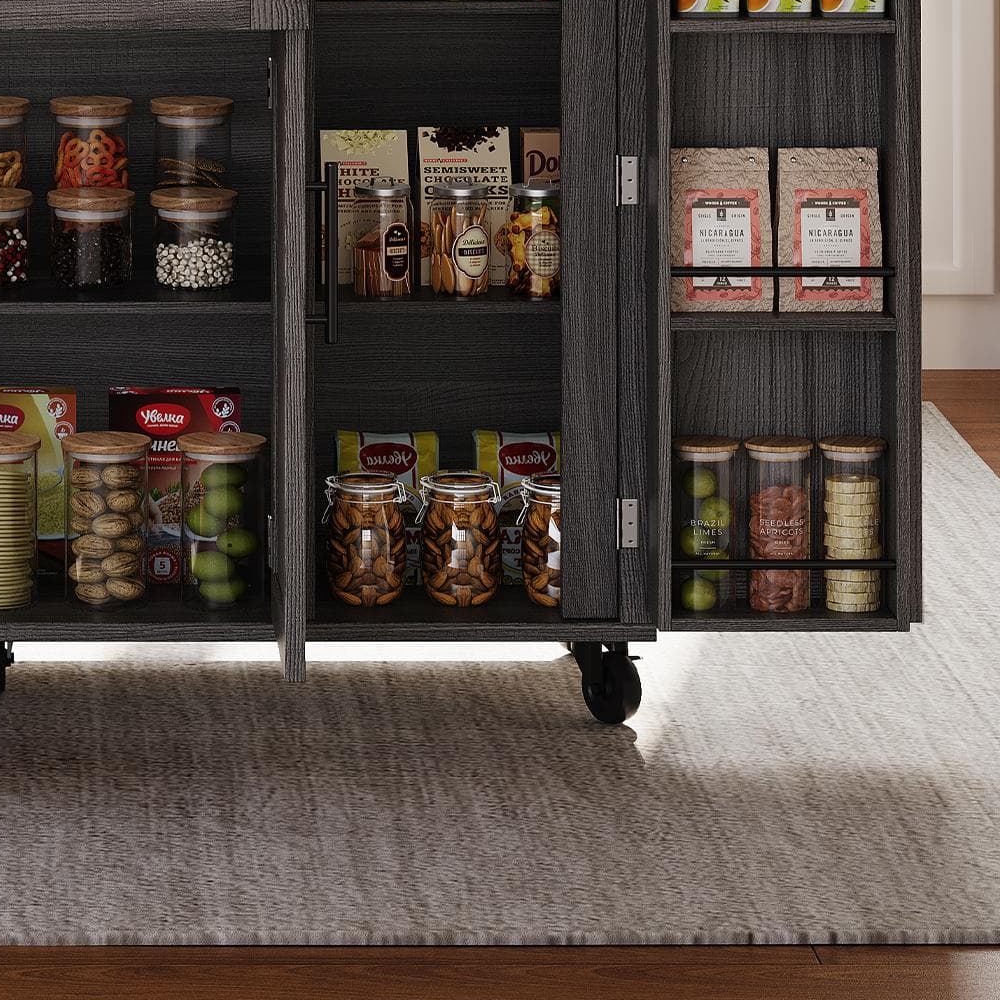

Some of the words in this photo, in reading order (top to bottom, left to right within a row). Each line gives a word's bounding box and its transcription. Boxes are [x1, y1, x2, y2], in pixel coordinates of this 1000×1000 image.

[338, 168, 380, 177] HITE
[423, 166, 507, 174] SEMISWEET
[424, 175, 509, 184] CHOCOLATE
[699, 229, 745, 237] NICARAGUA
[808, 229, 854, 237] NICARAGUA
[140, 409, 185, 425] Увелка
[690, 519, 725, 527] BRAZIL
[759, 519, 804, 527] SEEDLESS
[693, 528, 723, 536] LIMES
[759, 528, 804, 536] APRICOTS
[159, 560, 166, 570] 5
